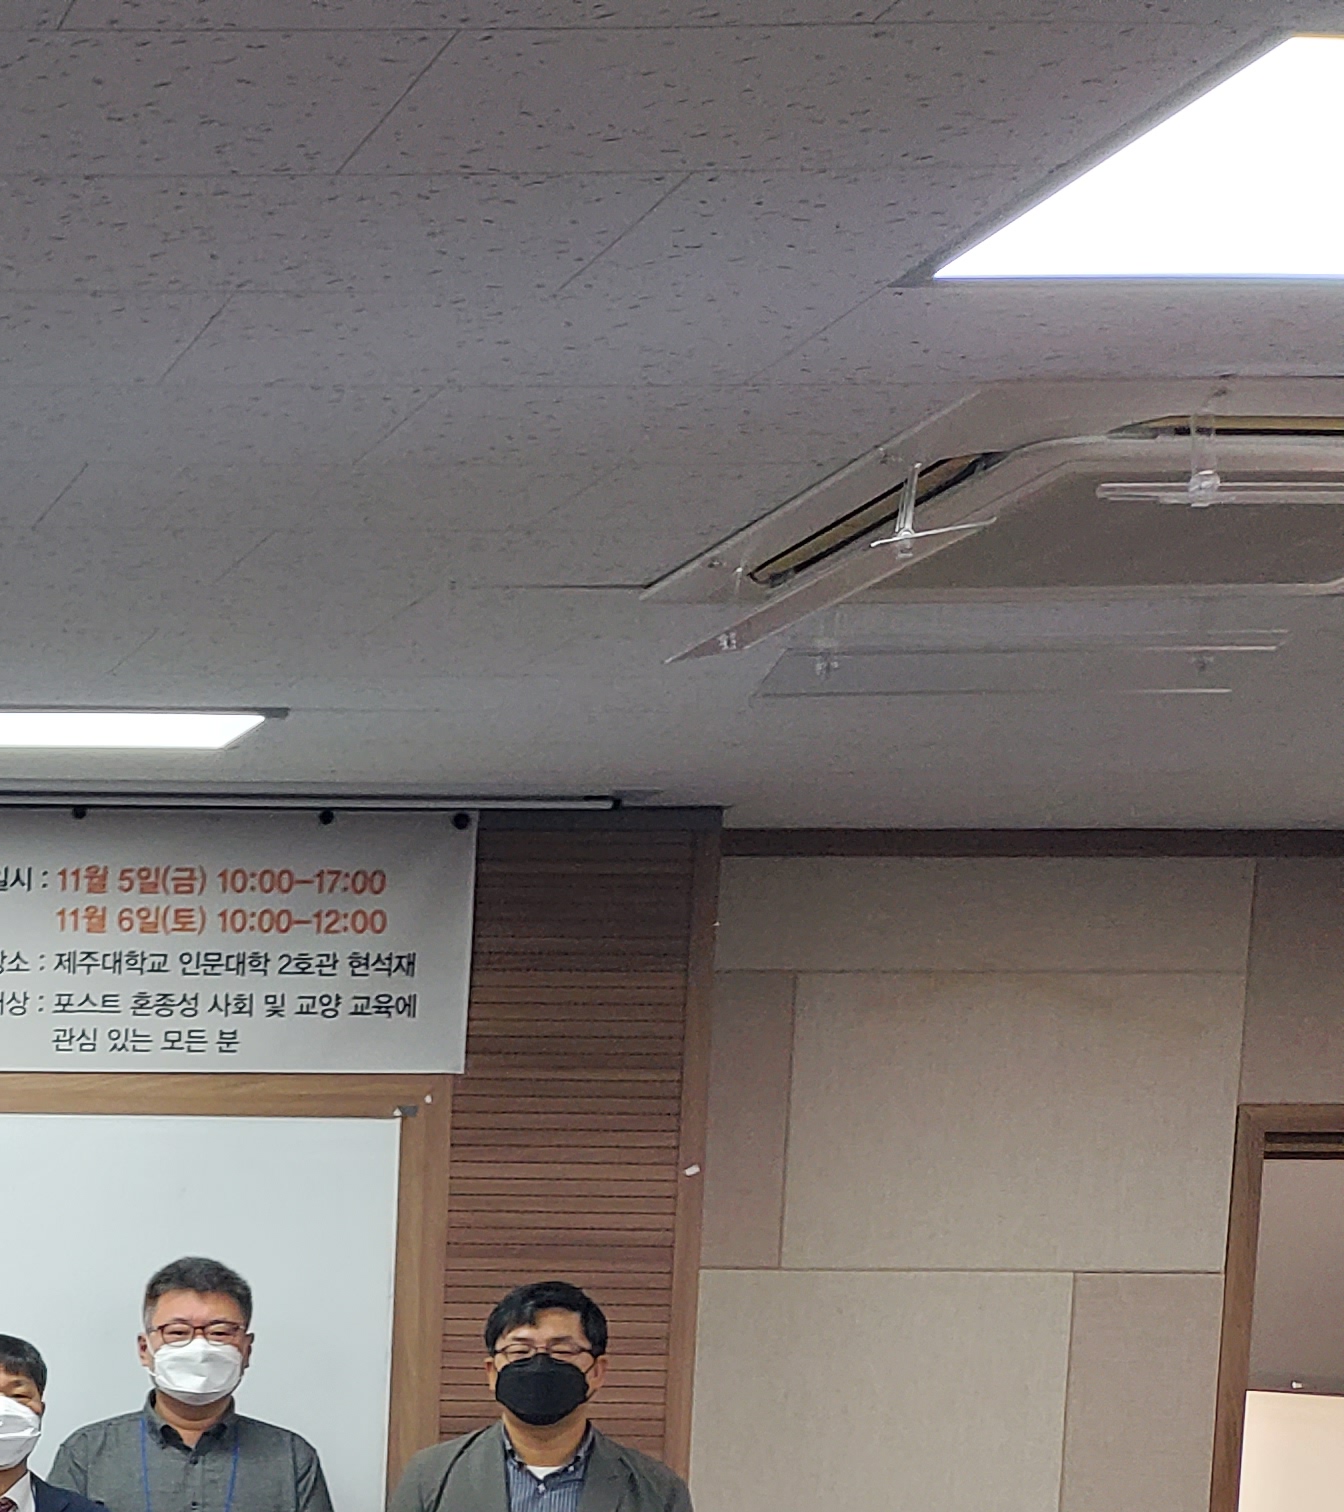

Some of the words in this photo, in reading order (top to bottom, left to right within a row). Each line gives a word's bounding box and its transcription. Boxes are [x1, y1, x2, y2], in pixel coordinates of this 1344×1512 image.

[58, 865, 109, 895] 11월
[117, 866, 207, 897] 5일(금)
[57, 905, 108, 934] 11월
[117, 906, 206, 935] 6일(토)
[53, 950, 171, 976] 제주대학교
[179, 951, 271, 977] 인문대학
[277, 951, 340, 977] 2호관
[347, 951, 417, 978] 현석재
[52, 993, 122, 1014] 포스트
[130, 991, 199, 1018] 혼종성
[207, 993, 254, 1018] 사회
[264, 993, 285, 1018] 및
[294, 993, 343, 1019] 교양
[348, 993, 417, 1019] 교육에
[51, 1027, 97, 1053] 관심
[107, 1028, 154, 1053] 있는
[160, 1029, 209, 1053] 모든
[215, 1029, 240, 1054] 분
